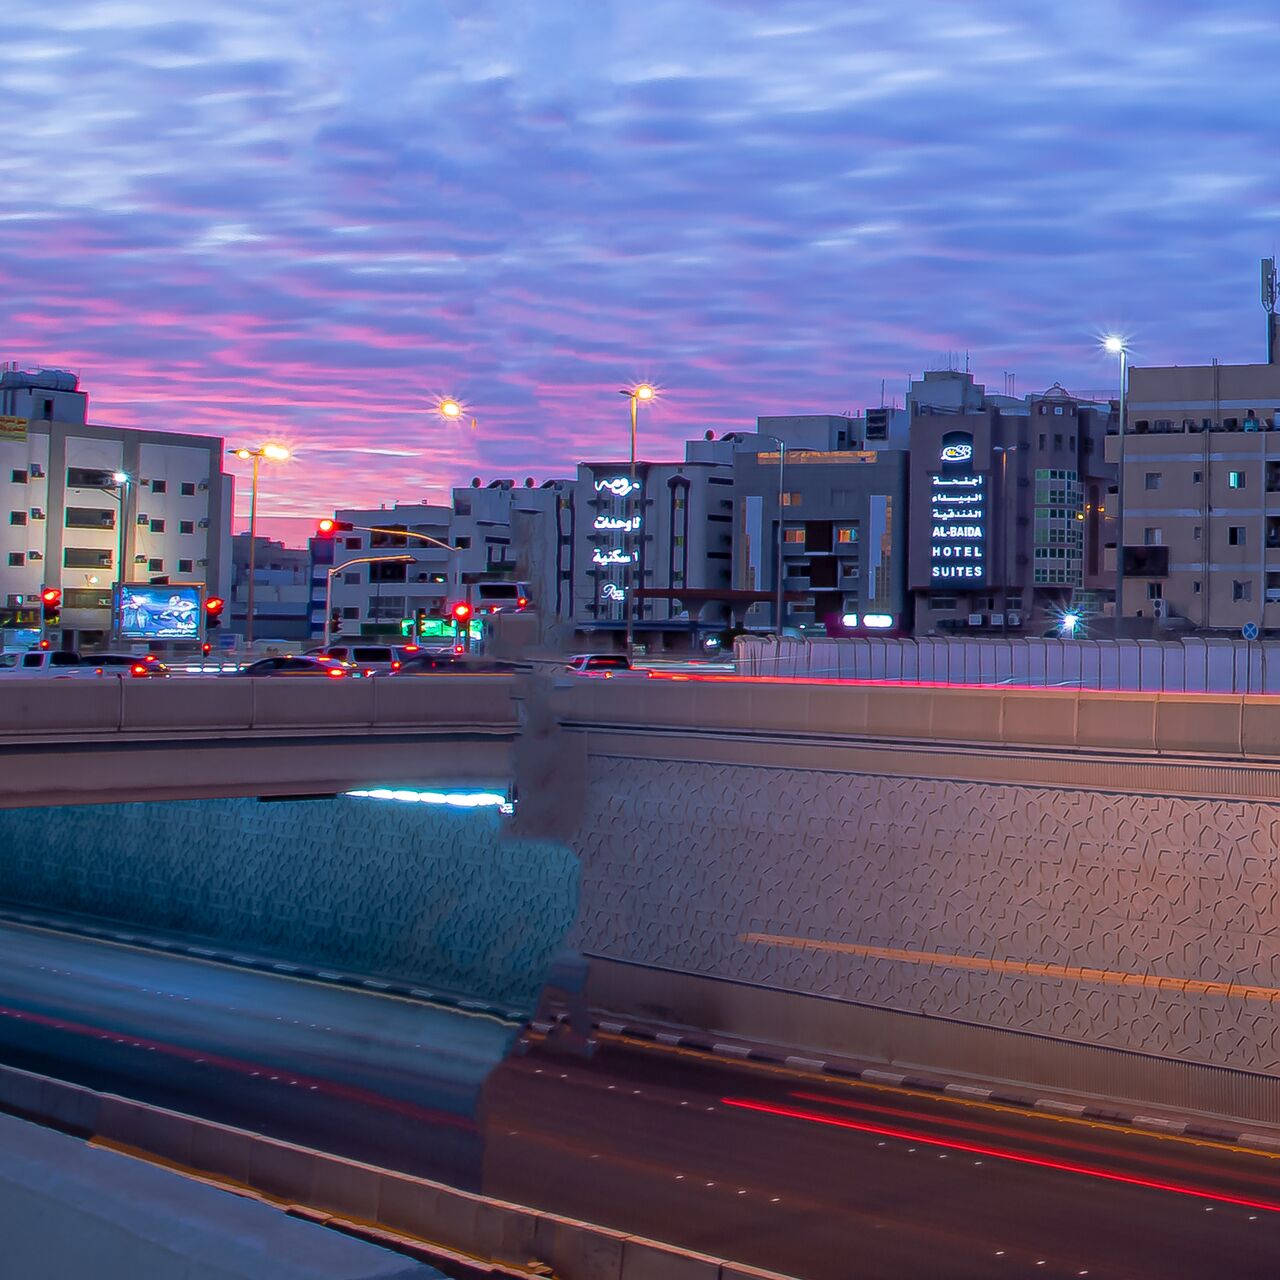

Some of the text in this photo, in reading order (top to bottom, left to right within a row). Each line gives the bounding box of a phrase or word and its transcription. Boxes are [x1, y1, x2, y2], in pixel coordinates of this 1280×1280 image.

[932, 527, 982, 537] AL-BAIDA
[932, 547, 982, 557] HOTEL
[932, 566, 982, 577] SUITES
